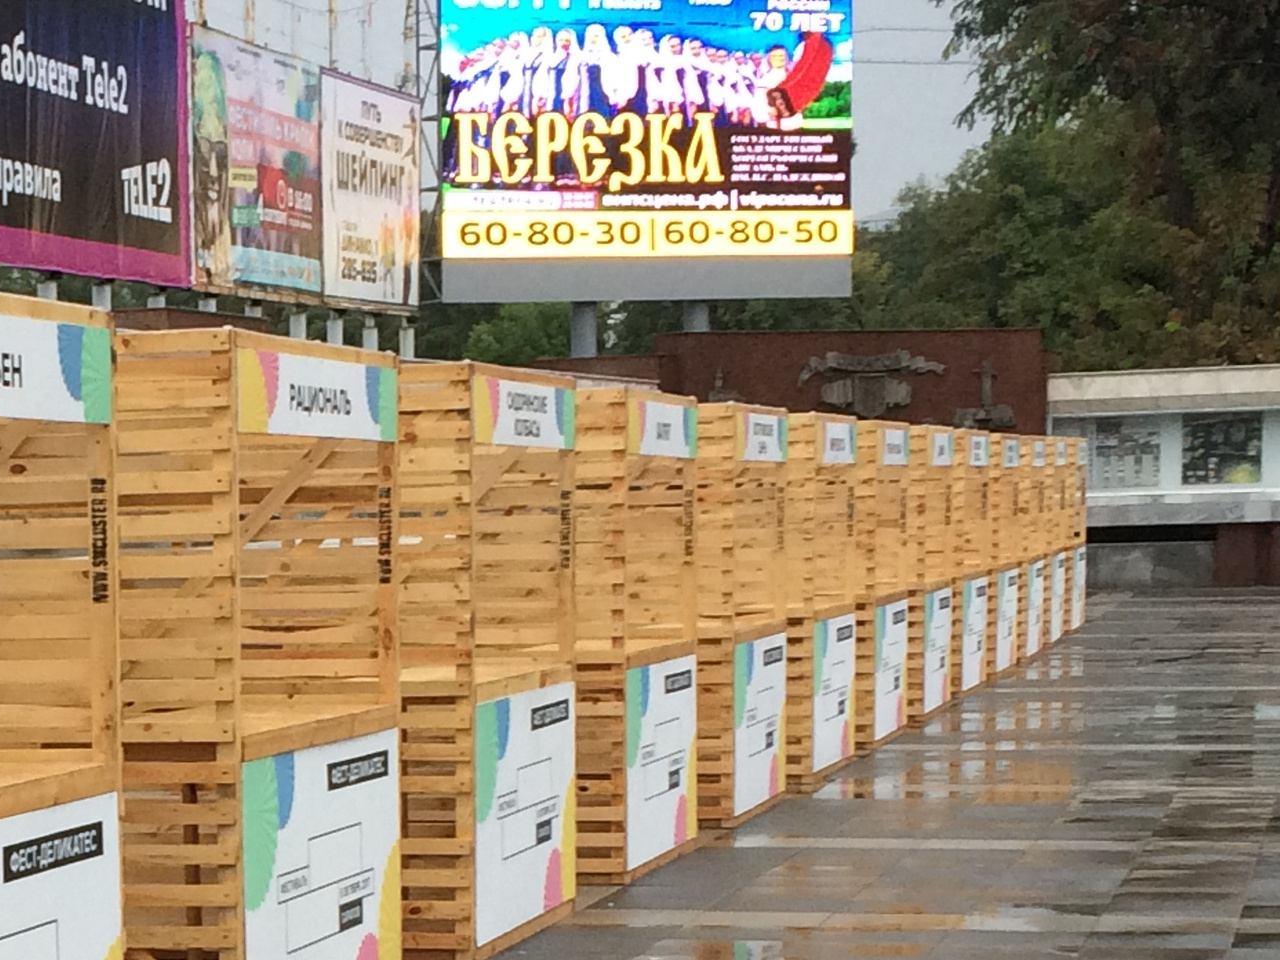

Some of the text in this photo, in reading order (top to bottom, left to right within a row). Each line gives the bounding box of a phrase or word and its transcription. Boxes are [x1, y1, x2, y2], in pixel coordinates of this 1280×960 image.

[750, 12, 846, 33] 70 ЛЕТ
[1, 30, 79, 101] абонент
[82, 55, 129, 115] Tele2
[454, 111, 725, 191] БЕРЕЗКА
[121, 158, 173, 223] TELE2
[336, 150, 405, 205] ШЕЙПИНГ
[460, 220, 838, 246] 60-80-30 60-80-50
[289, 383, 352, 416] РАЦИОНАЛЬ
[9, 829, 98, 874] ФЕСТ-ДЕЛИКАТЕС
